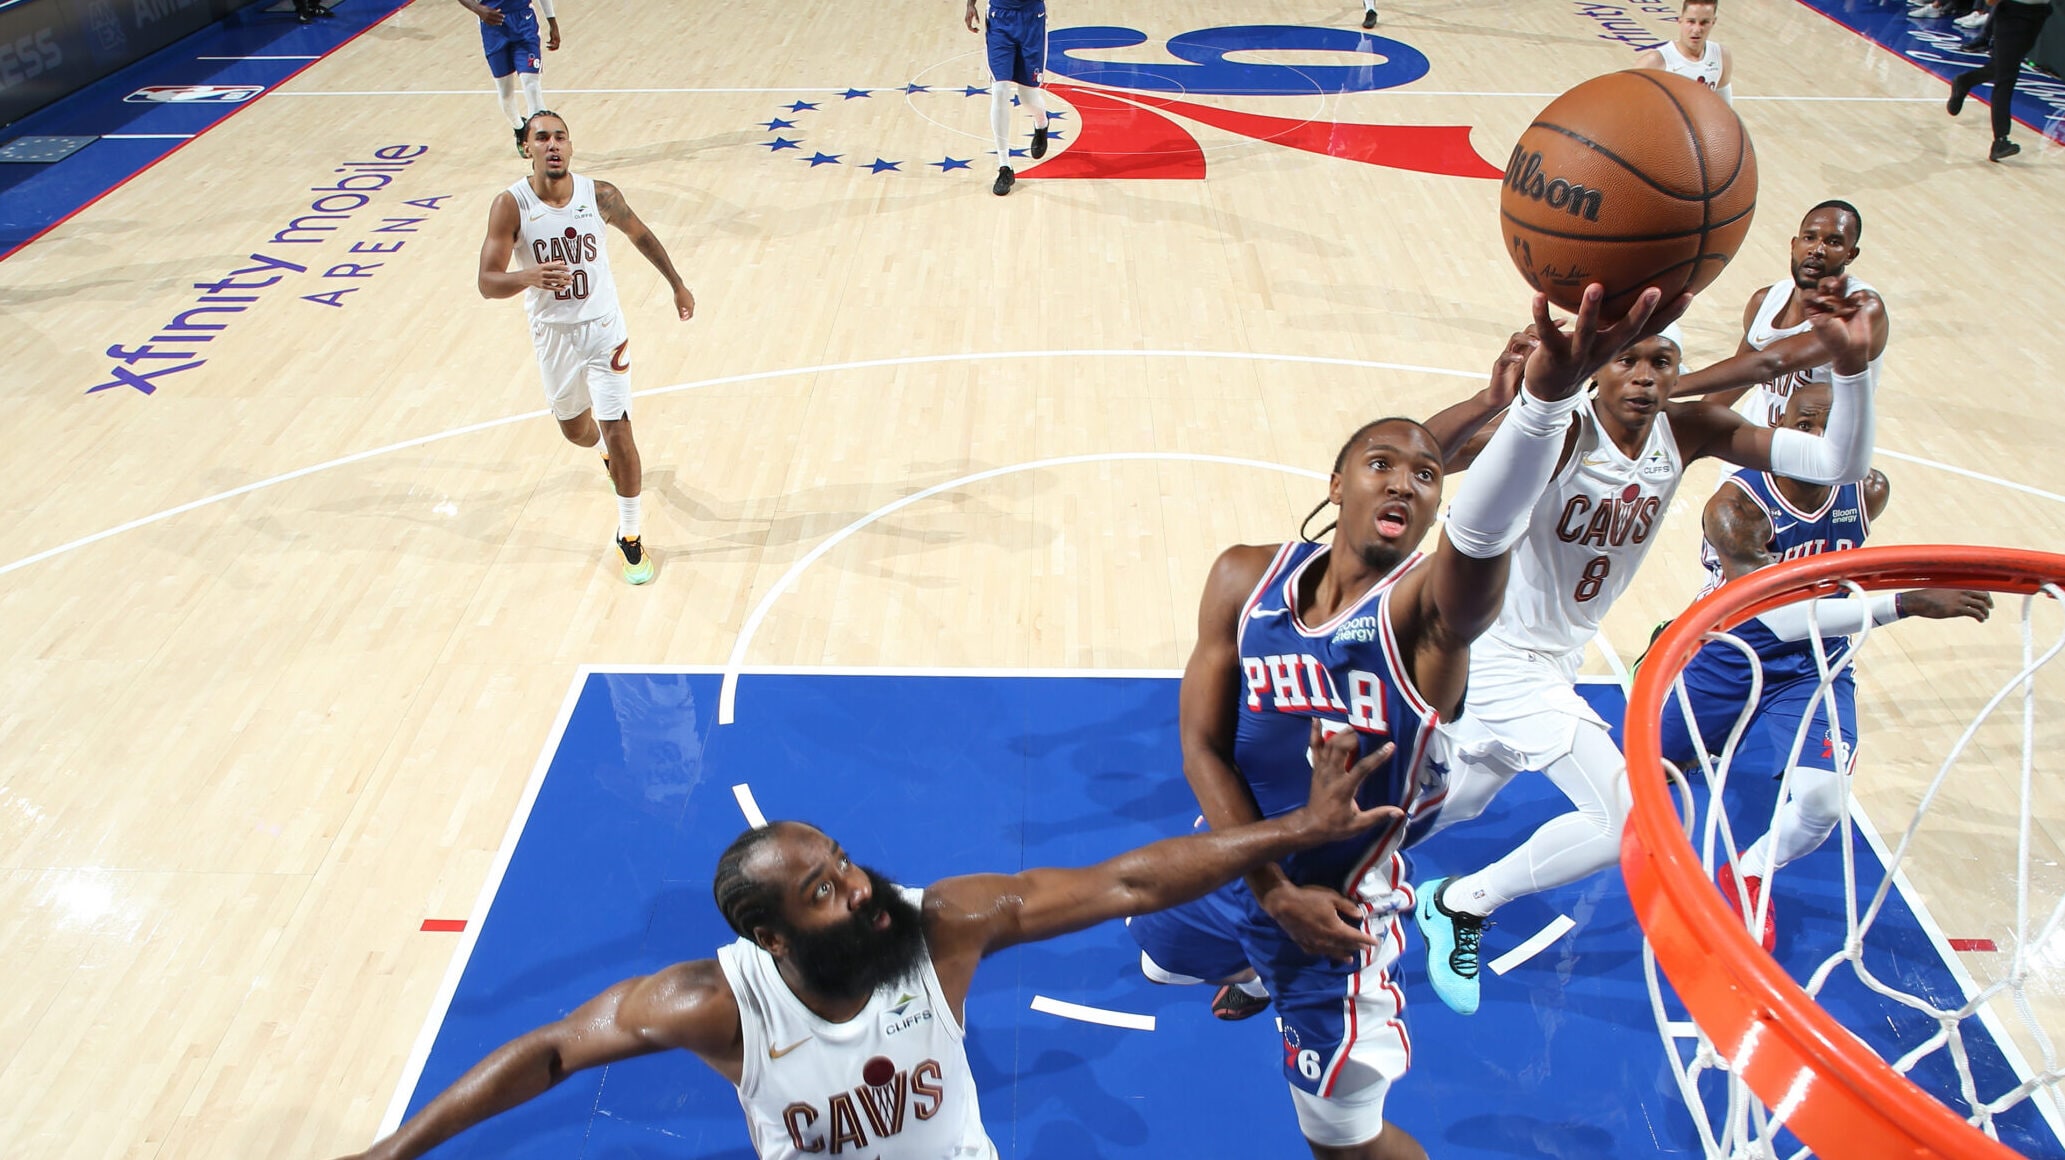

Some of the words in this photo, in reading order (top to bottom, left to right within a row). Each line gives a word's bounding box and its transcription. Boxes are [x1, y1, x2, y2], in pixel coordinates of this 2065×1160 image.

[300, 195, 453, 308] ARENA
[533, 230, 598, 265] CAVS
[85, 253, 308, 396] xfinity
[268, 145, 429, 243] mobile
[1643, 465, 1671, 475] CLIFFS
[1556, 485, 1662, 547] CAVS
[1832, 508, 1858, 518] Bloom
[1832, 515, 1857, 524] energy
[1573, 555, 1611, 603] 8
[1336, 615, 1377, 630] oom
[886, 1009, 933, 1036] CLIFFS
[782, 1056, 944, 1156] CAVS
